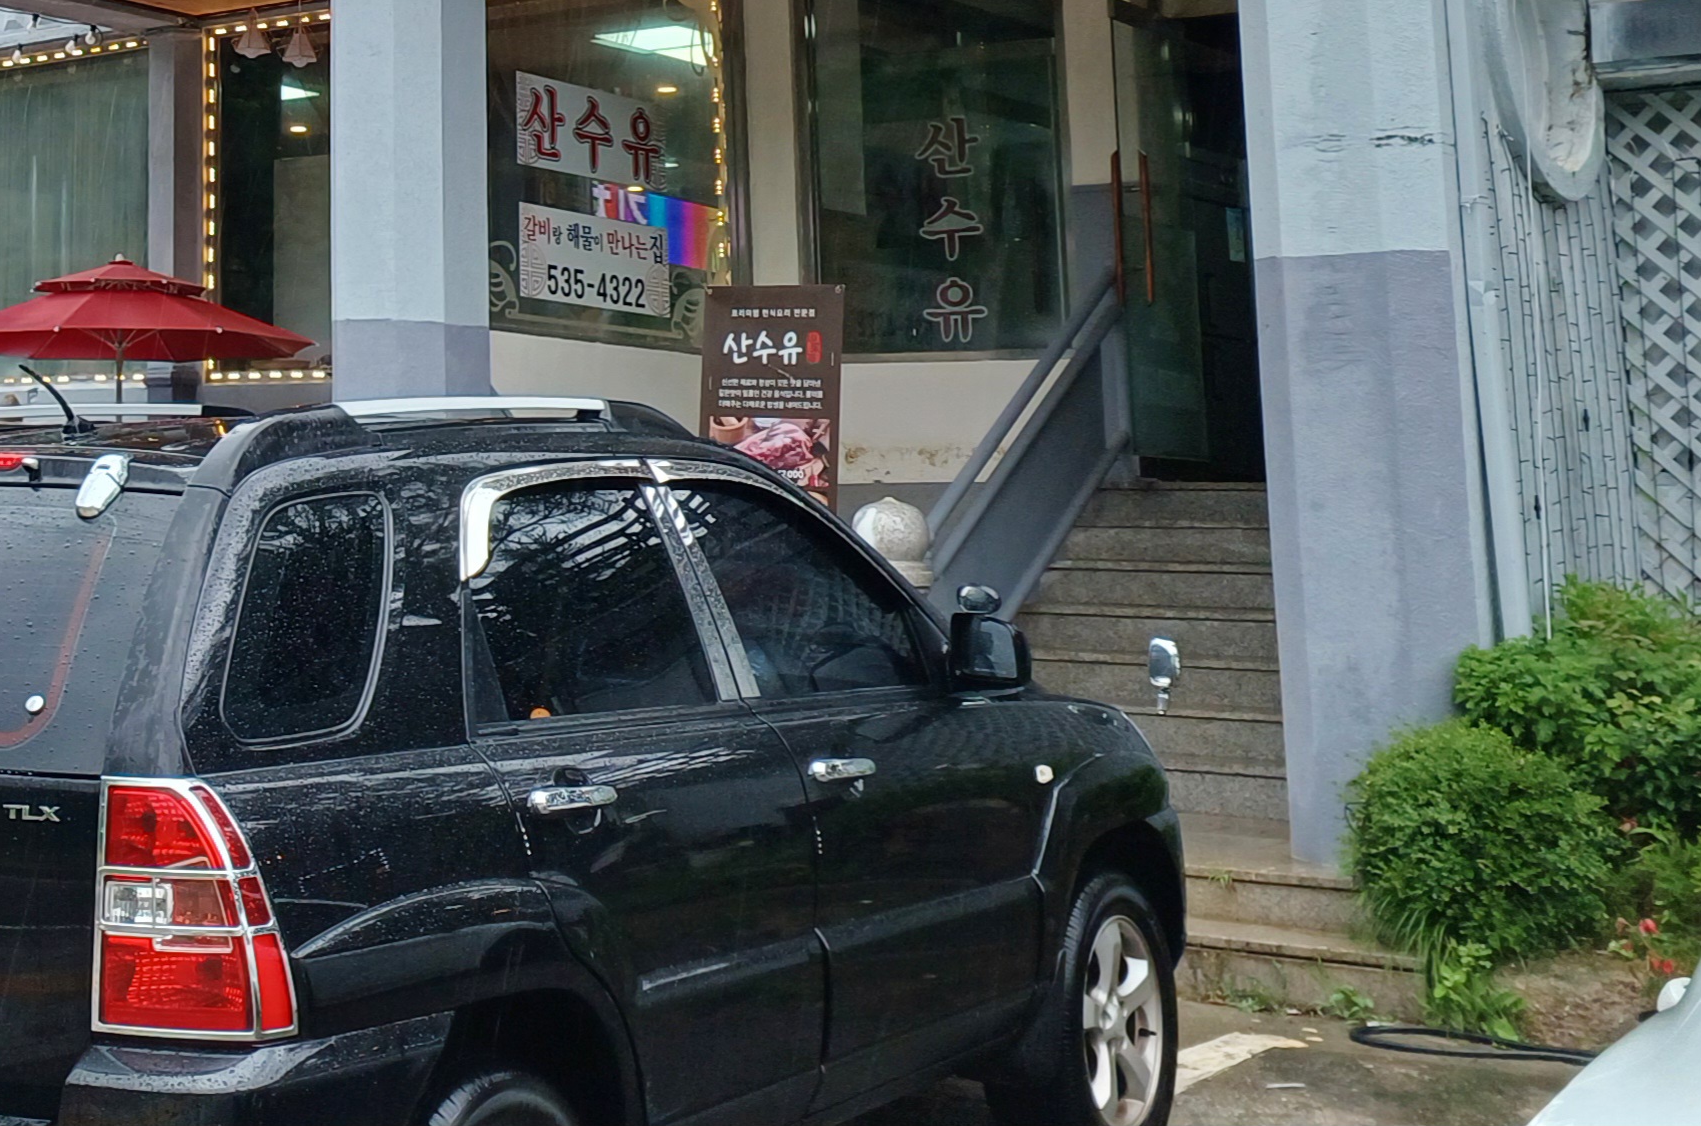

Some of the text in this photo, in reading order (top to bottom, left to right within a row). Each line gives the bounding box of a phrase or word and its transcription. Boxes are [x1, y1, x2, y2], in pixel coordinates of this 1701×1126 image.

[521, 84, 661, 182] 산수유
[524, 215, 563, 245] 갈비랑
[566, 223, 603, 252] 해물이
[915, 116, 988, 343] 산수유
[547, 264, 646, 309] 535-4322
[723, 330, 803, 365] 산수유
[2, 803, 61, 823] TLX
